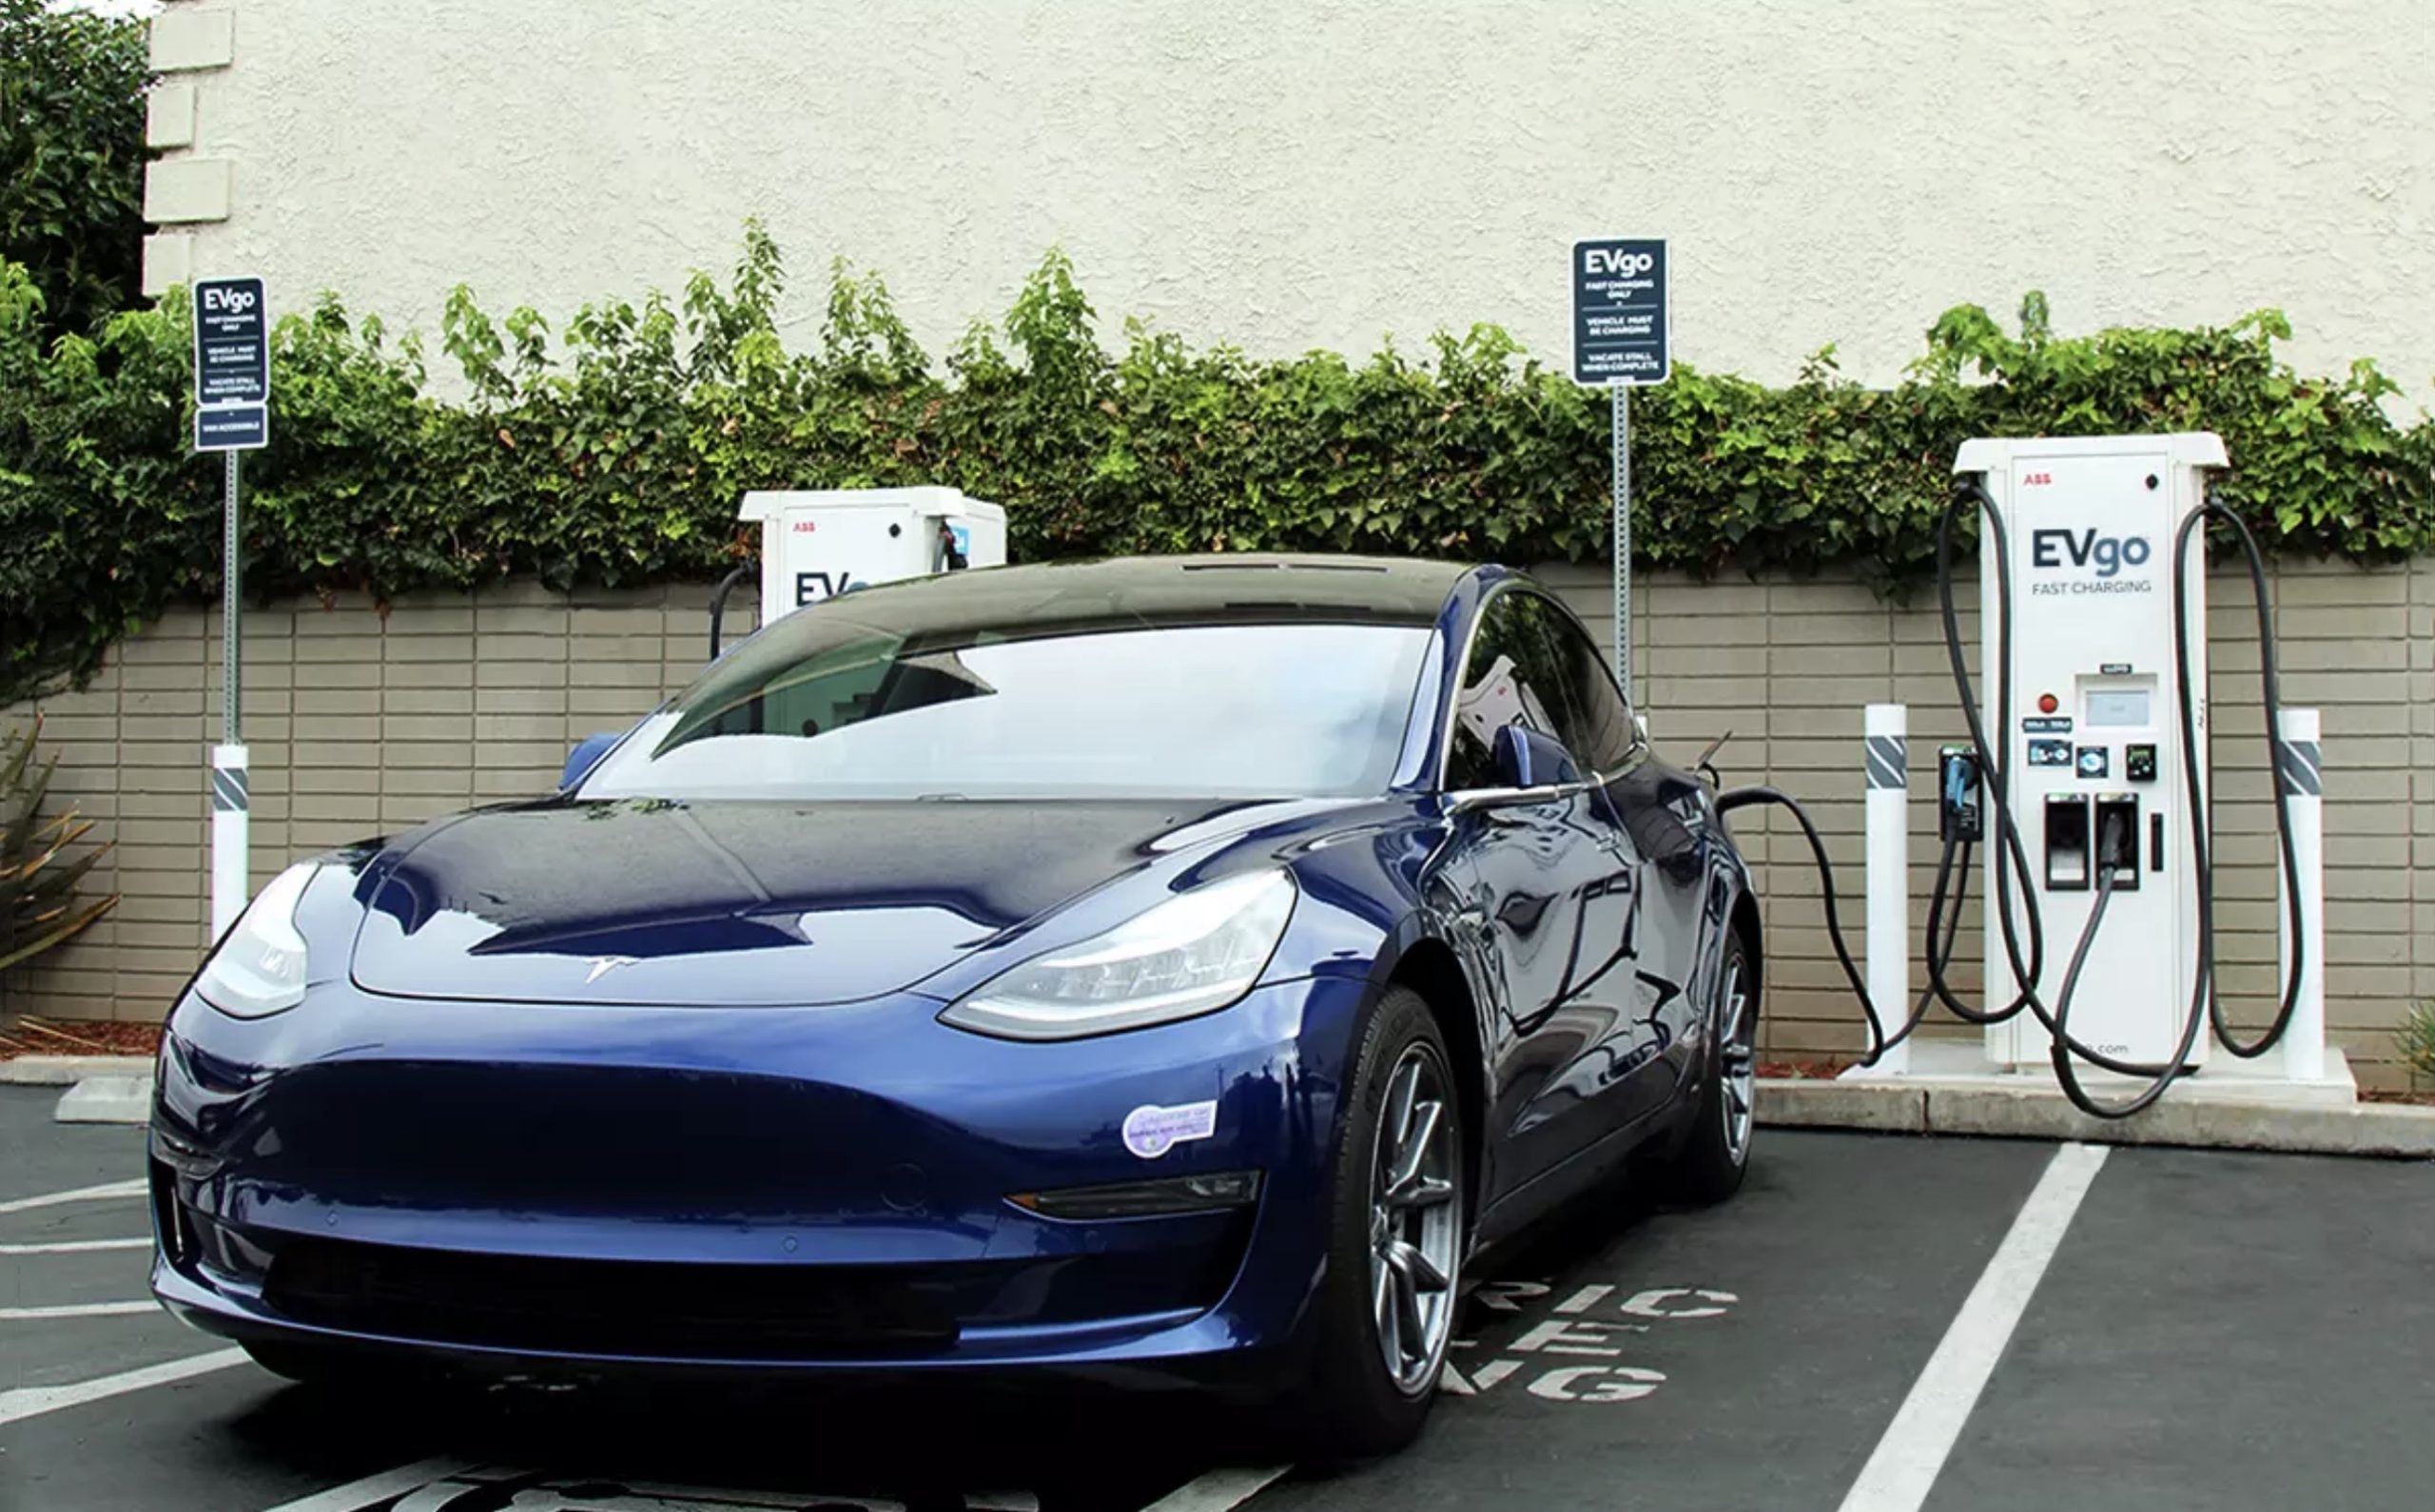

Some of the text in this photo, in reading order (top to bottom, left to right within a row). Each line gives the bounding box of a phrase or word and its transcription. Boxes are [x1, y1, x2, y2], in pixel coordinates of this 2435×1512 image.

[1585, 248, 1653, 278] EVgo
[205, 288, 256, 314] EVgo
[1607, 289, 1633, 300] ONLY
[1587, 315, 1653, 326] VEHICLE MUST
[1589, 327, 1602, 337] BE
[2023, 474, 2052, 485] ABB
[792, 522, 815, 533] ABB
[2033, 528, 2151, 576] EVgo
[796, 572, 869, 607] EV
[2033, 580, 2152, 596] FAST CHARGING
